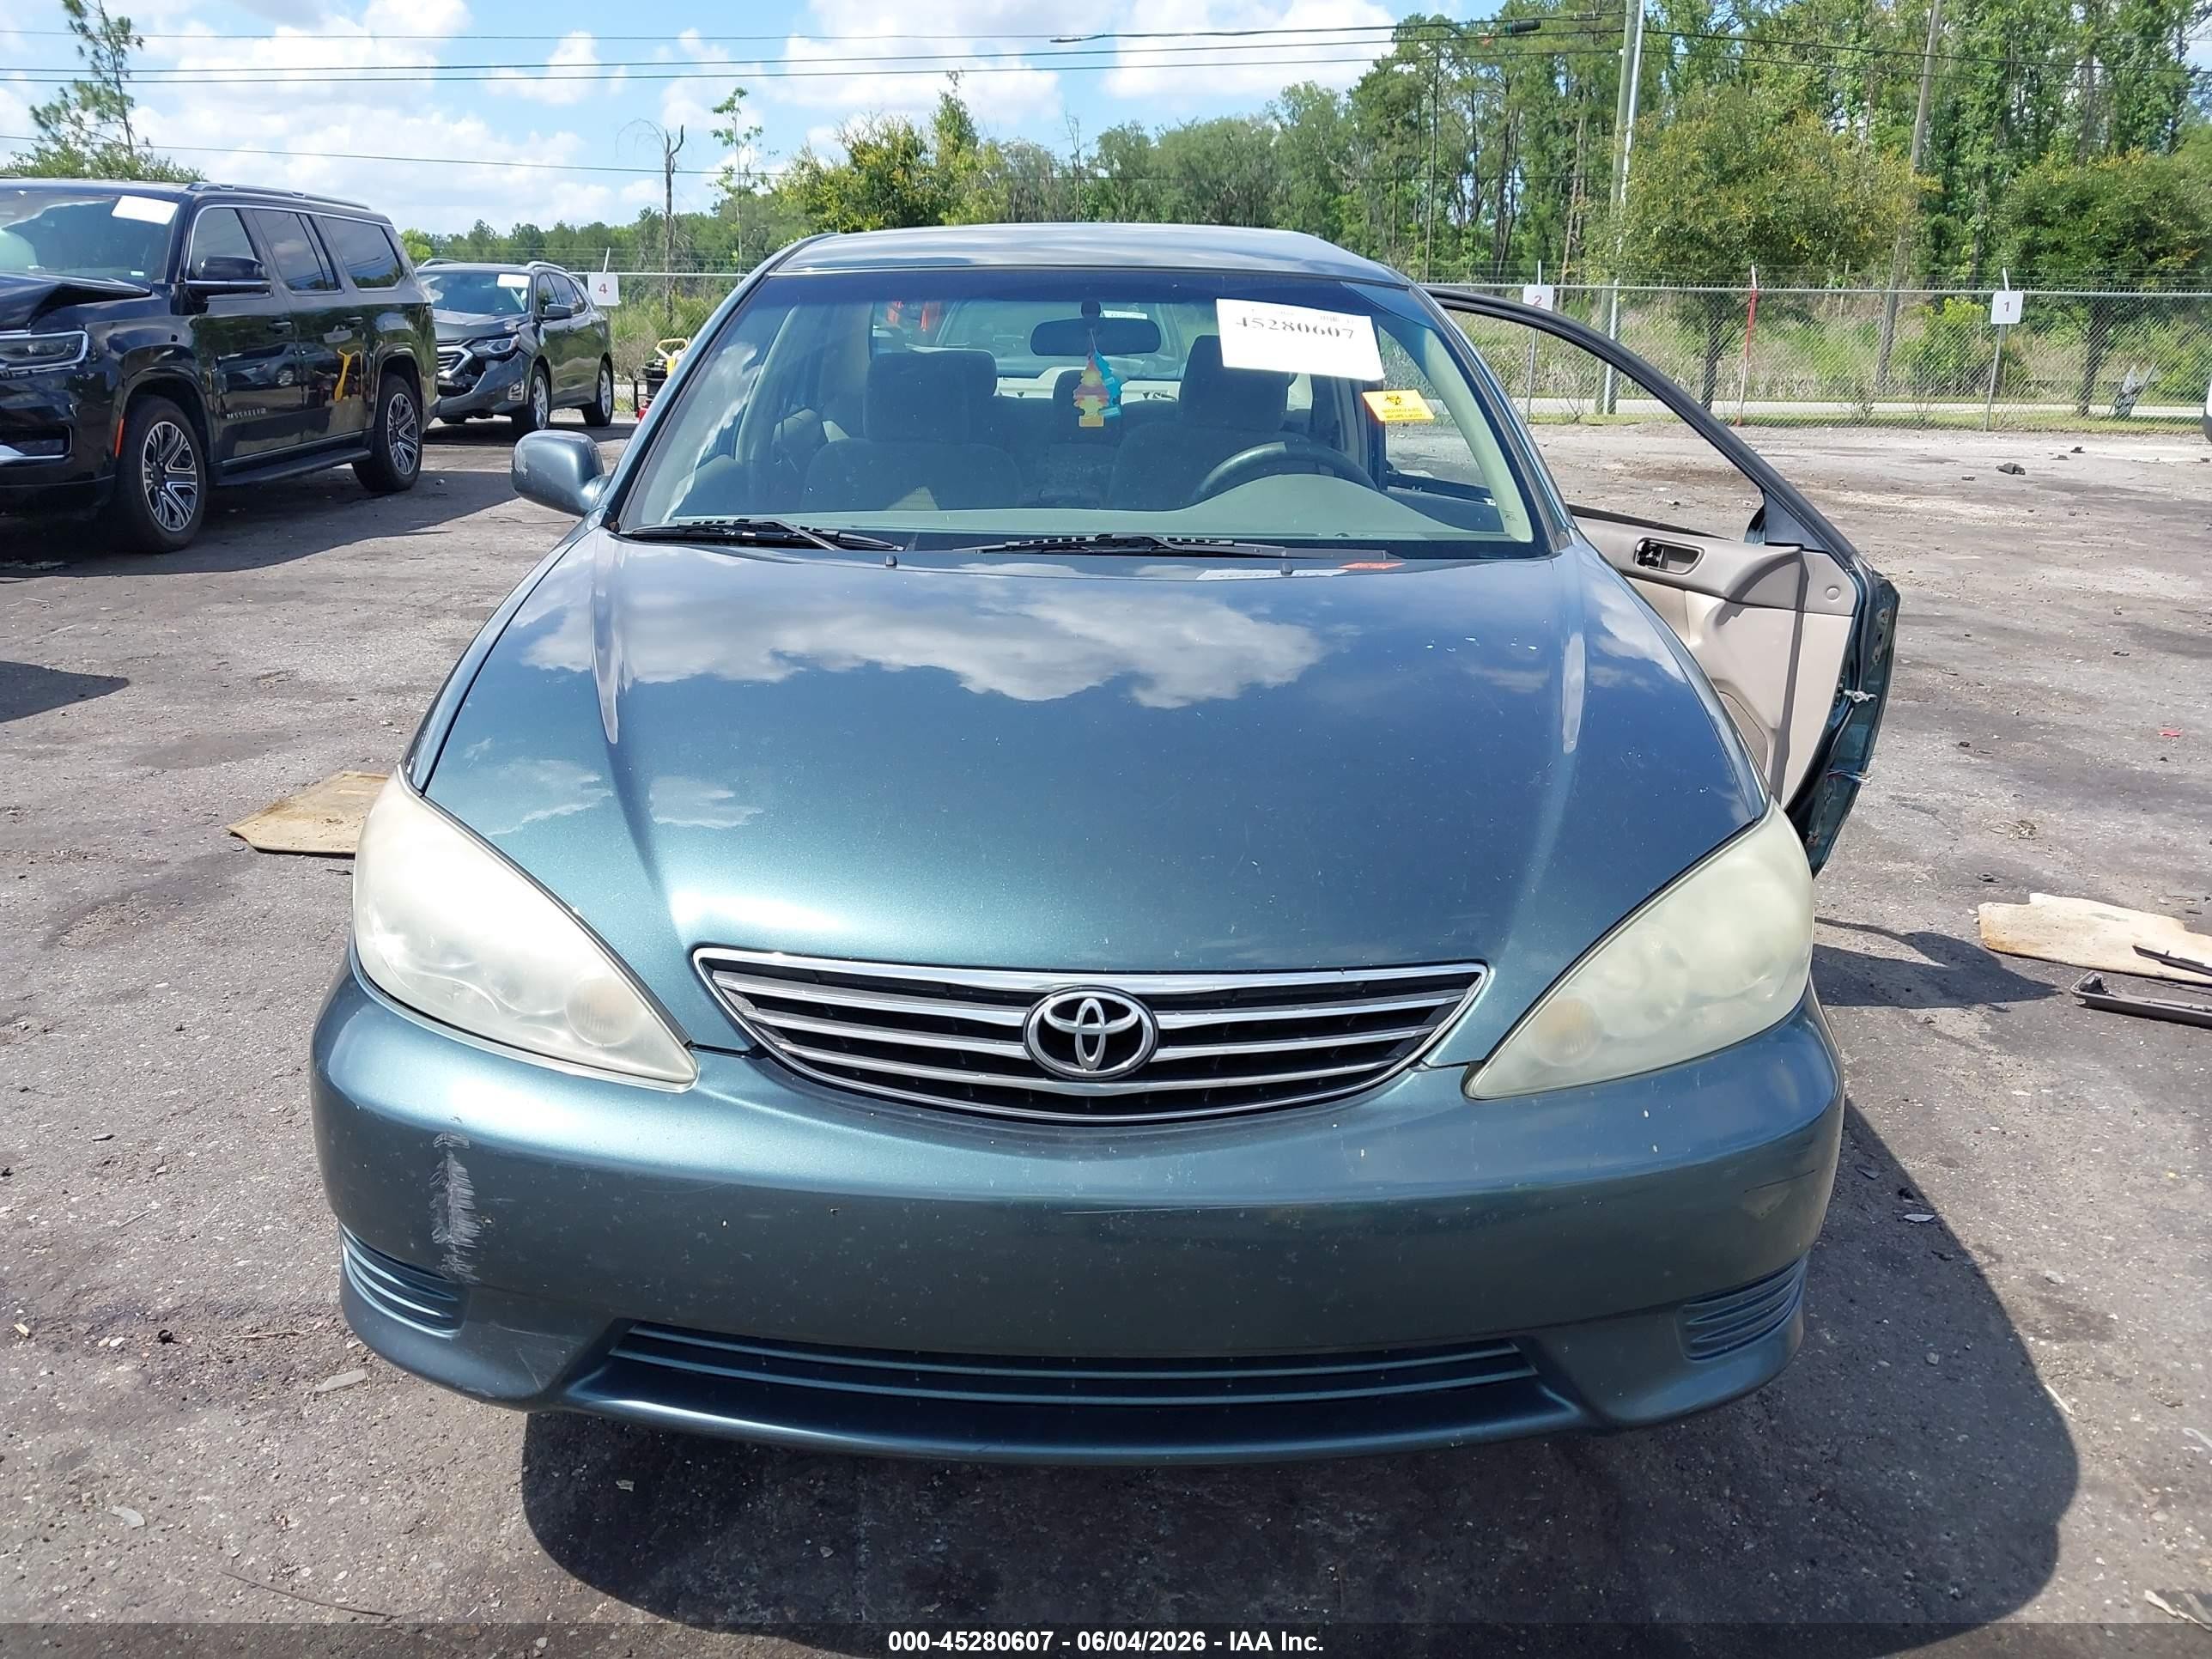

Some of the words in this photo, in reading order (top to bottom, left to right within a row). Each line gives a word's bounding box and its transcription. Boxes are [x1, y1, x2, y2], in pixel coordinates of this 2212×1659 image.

[599, 283, 608, 295] 4
[1533, 295, 1542, 307] 2
[2003, 301, 2011, 313] 1
[1236, 316, 1354, 339] 45280607
